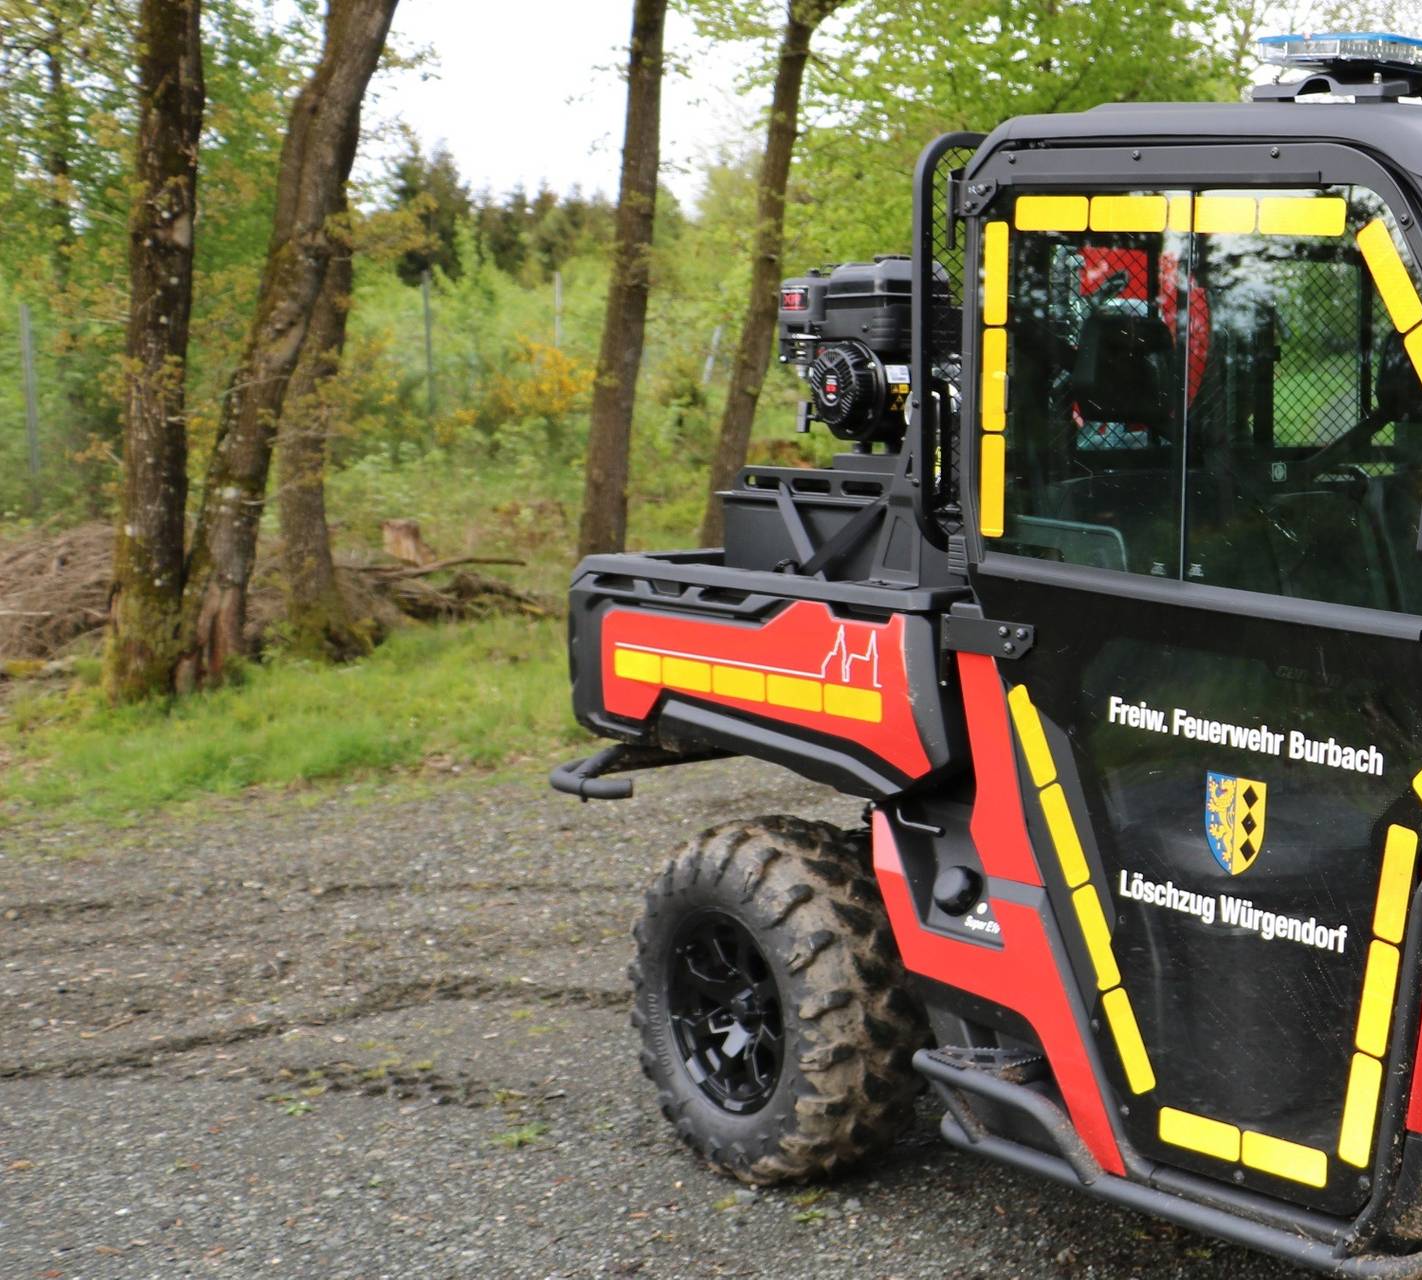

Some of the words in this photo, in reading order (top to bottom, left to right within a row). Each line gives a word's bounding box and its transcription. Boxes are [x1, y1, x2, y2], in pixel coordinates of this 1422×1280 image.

[1108, 695, 1168, 734] Freiw.
[1172, 708, 1285, 756] Feuerwehr
[1288, 730, 1384, 776] Burbach
[1118, 869, 1216, 925] Löschzug
[1219, 894, 1348, 954] Würgendorf
